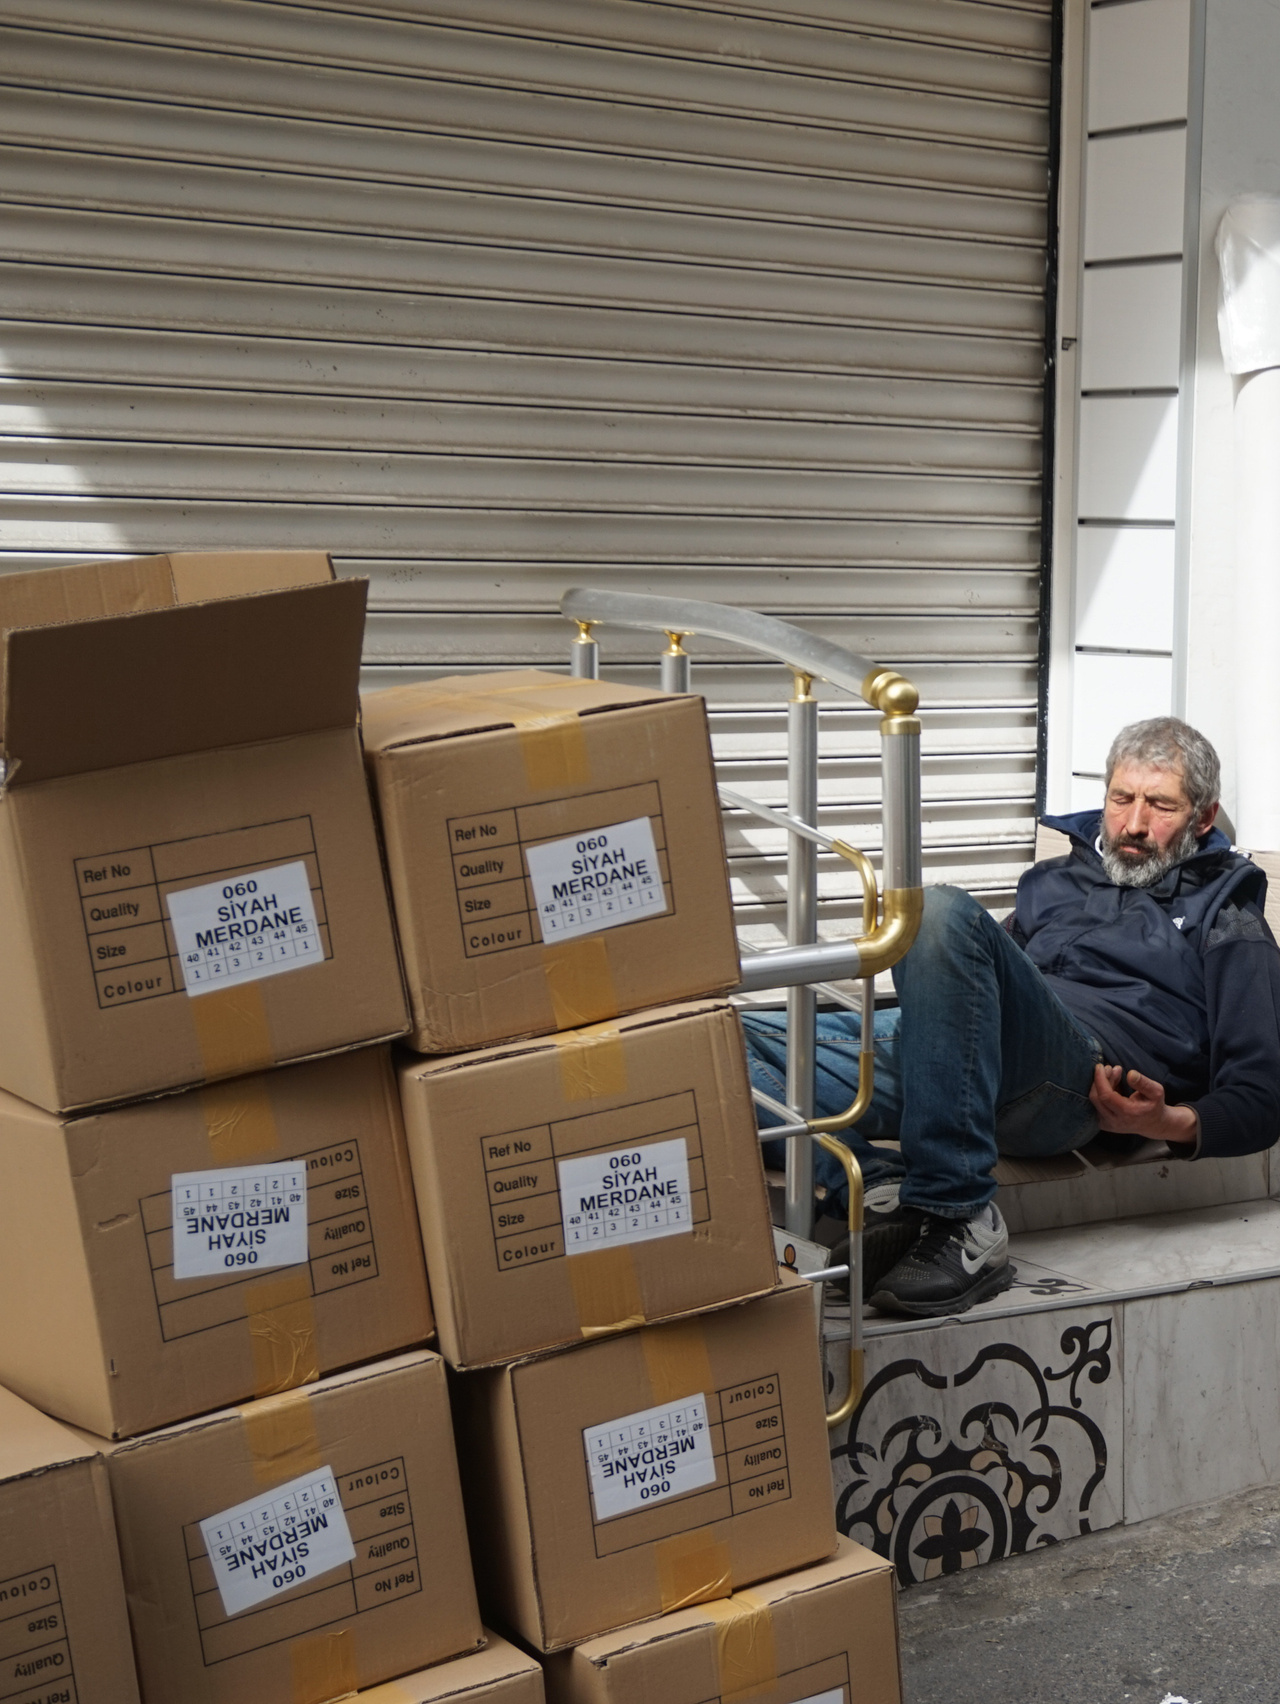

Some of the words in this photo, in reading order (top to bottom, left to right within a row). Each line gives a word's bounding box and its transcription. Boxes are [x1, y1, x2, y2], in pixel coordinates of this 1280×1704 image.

[455, 828, 477, 842] Ref
[480, 824, 497, 836] No
[576, 835, 607, 853] 060
[460, 860, 504, 877] Quality
[572, 848, 625, 875] SİYAH
[83, 868, 107, 883] Ref
[111, 864, 131, 878] No
[552, 860, 648, 899] MERDANE
[223, 880, 257, 899] 060
[544, 904, 555, 913] 40
[562, 899, 573, 907] 41
[582, 893, 592, 902] 42
[602, 887, 613, 896] 43
[622, 882, 632, 890] 44
[641, 876, 652, 884] 45
[90, 901, 140, 922] Quality
[218, 894, 278, 922] SİYAH
[465, 898, 491, 913] Size
[568, 913, 574, 922] 2
[586, 908, 592, 916] 3
[607, 902, 613, 910] 2
[195, 907, 303, 948] MERDANE
[187, 953, 200, 963] 40
[207, 947, 220, 957] 41
[229, 942, 241, 951] 42
[252, 936, 264, 945] 43
[274, 930, 286, 940] 44
[295, 924, 308, 933] 45
[470, 928, 521, 949] Colour
[97, 943, 126, 960] Size
[195, 970, 200, 978] 1
[214, 964, 221, 973] 2
[234, 959, 240, 967] 3
[257, 952, 263, 961] 2
[280, 946, 286, 954] 1
[303, 941, 309, 949] 1
[104, 975, 163, 998] Colour
[489, 1145, 511, 1159] Ref
[514, 1140, 532, 1154] No
[610, 1153, 641, 1169] 060
[273, 1181, 278, 1189] 2
[292, 1178, 296, 1186] 1
[493, 1175, 538, 1194] Quality
[602, 1167, 657, 1190] SİYAH
[186, 1190, 190, 1198] 1
[209, 1188, 214, 1196] 1
[231, 1186, 237, 1194] 2
[254, 1183, 260, 1191] 3
[335, 1185, 359, 1199] Size
[250, 1199, 261, 1207] 42
[271, 1197, 282, 1205] 41
[290, 1194, 301, 1202] 40
[580, 1180, 678, 1212] MERDANE
[184, 1207, 195, 1215] 45
[206, 1204, 218, 1212] 44
[228, 1202, 240, 1210] 43
[570, 1216, 581, 1225] 40
[588, 1212, 599, 1220] 41
[608, 1208, 619, 1217] 42
[629, 1204, 640, 1212] 43
[650, 1200, 661, 1208] 44
[670, 1196, 681, 1204] 45
[187, 1207, 289, 1234] MERDANE
[498, 1213, 525, 1227] Size
[593, 1227, 598, 1235] 2
[611, 1223, 616, 1231] 3
[633, 1218, 638, 1226] 2
[675, 1211, 680, 1219] 1
[324, 1221, 365, 1240] Quality
[209, 1229, 266, 1250] SİYAH
[224, 1251, 258, 1267] 060
[503, 1241, 555, 1262] Colour
[332, 1262, 348, 1275] No
[352, 1255, 371, 1271] Ref
[729, 1383, 774, 1404] Colour
[676, 1415, 681, 1423] 2
[693, 1422, 703, 1431] 40
[756, 1416, 778, 1429] Size
[619, 1433, 624, 1441] 1
[639, 1427, 644, 1435] 2
[657, 1434, 668, 1443] 42
[676, 1428, 686, 1437] 41
[618, 1447, 628, 1456] 44
[638, 1441, 648, 1449] 43
[598, 1453, 609, 1463] 45
[602, 1436, 695, 1478] MERDANE
[744, 1448, 781, 1466] Quality
[349, 1467, 399, 1491] Colour
[624, 1460, 676, 1488] SİYAH
[321, 1484, 326, 1492] 1
[640, 1481, 670, 1499] 060
[749, 1485, 764, 1497] No
[767, 1479, 784, 1494] Ref
[302, 1493, 309, 1501] 2
[323, 1497, 334, 1508] 40
[284, 1502, 291, 1510] 3
[304, 1507, 316, 1517] 41
[380, 1502, 405, 1517] Size
[262, 1511, 269, 1520] 2
[284, 1516, 296, 1526] 42
[240, 1521, 246, 1529] 1
[263, 1525, 275, 1536] 43
[217, 1531, 223, 1539] 1
[225, 1513, 328, 1571] MERDANE
[241, 1535, 253, 1545] 44
[219, 1545, 231, 1556] 45
[368, 1537, 410, 1559] Quality
[252, 1542, 309, 1579] SİYAH
[272, 1565, 306, 1588] 060
[395, 1571, 414, 1587] Ref
[375, 1579, 391, 1592] No
[28, 1615, 58, 1632] Size
[14, 1653, 64, 1678] Quality
